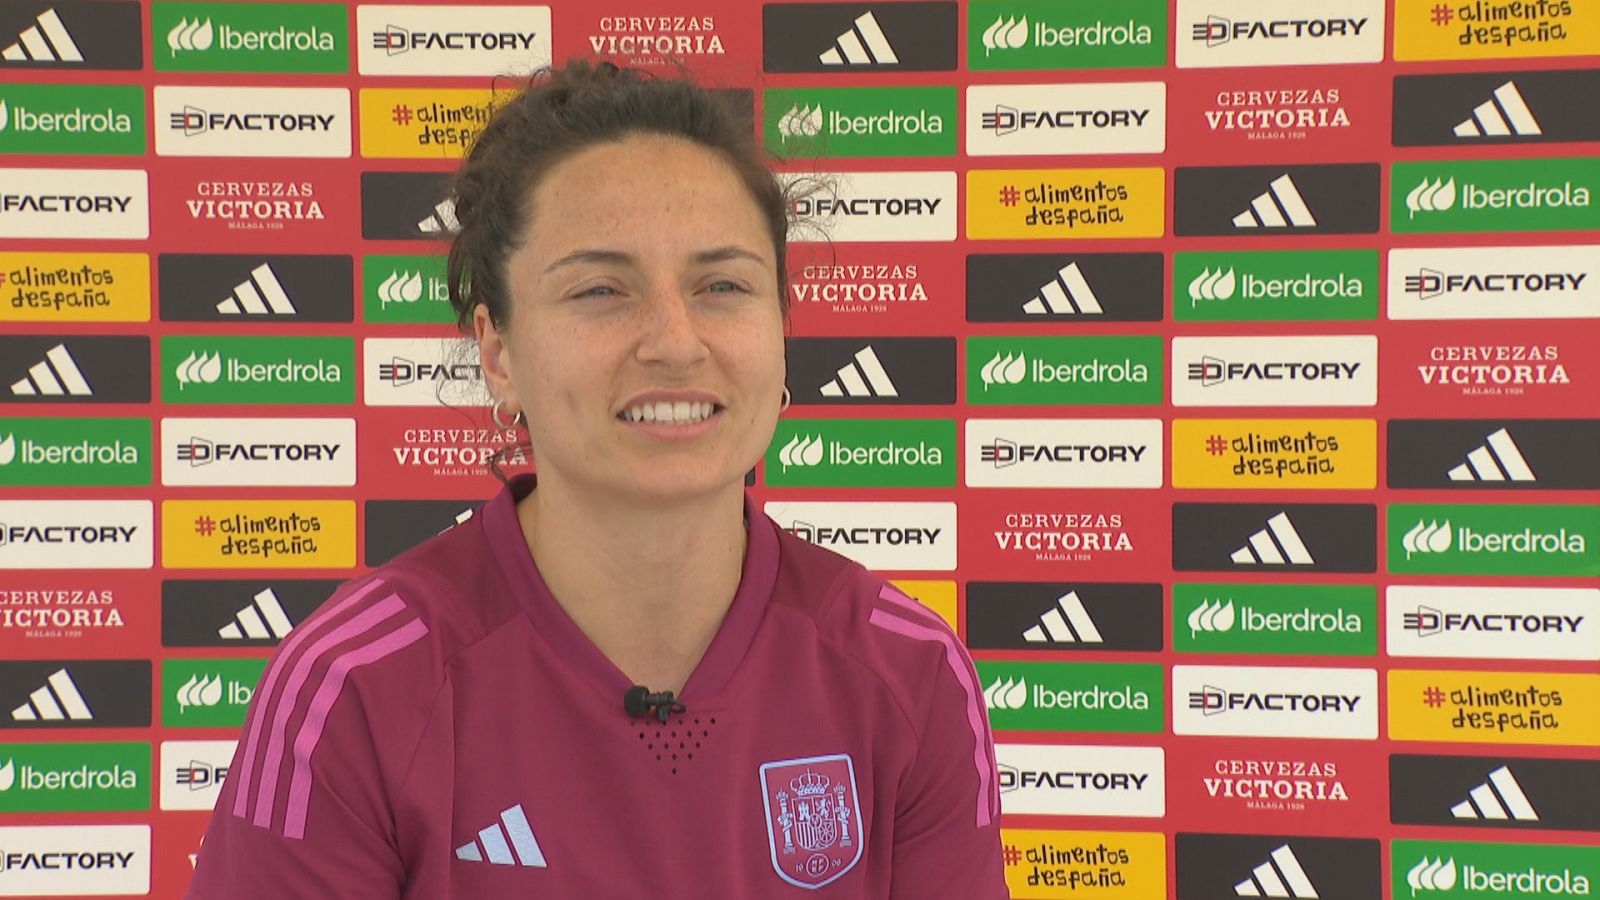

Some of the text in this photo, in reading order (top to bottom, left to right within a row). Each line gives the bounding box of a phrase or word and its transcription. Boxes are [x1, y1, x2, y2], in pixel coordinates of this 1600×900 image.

[600, 17, 713, 31] CERVEZAS
[1035, 20, 1151, 46] Iberdrola
[220, 26, 333, 50] Iberdrola
[588, 34, 725, 56] VICTORIA
[1218, 89, 1339, 106] CERVEZAS
[14, 107, 130, 132] Iberdrola
[391, 103, 495, 126] #alimen
[830, 110, 942, 134] Iberdrola
[1205, 108, 1350, 129] VICTORIA
[419, 126, 477, 146] desp
[198, 182, 312, 196] CERVEZAS
[1463, 182, 1589, 208] Iberdrola
[187, 200, 324, 219] VICTORIA
[803, 265, 917, 281] CERVEZAS
[792, 282, 929, 302] VICTORIA
[1243, 273, 1362, 298] Iberdrola
[1431, 346, 1558, 360] CERVEZAS
[228, 358, 340, 382] Iberdrola
[418, 364, 481, 380] FACT
[1033, 359, 1147, 382] Iberdrola
[1418, 365, 1569, 384] VICTORIA
[404, 428, 517, 444] CERVEZAS
[22, 440, 137, 464] Iberdrola
[830, 442, 941, 464] Iberdrola
[1006, 514, 1121, 528] CERVEZAS
[995, 532, 1133, 550] VICTORIA
[1460, 528, 1585, 553] Iberdrola
[0, 609, 123, 627] ICTORIA
[1242, 607, 1361, 632] Iberdrola
[1034, 685, 1148, 709] Iberdrola
[21, 765, 136, 789] Iberdrola
[1216, 760, 1336, 777] CERVEZAS
[1204, 779, 1348, 800] VICTORIA
[1464, 865, 1589, 894] Iberdrola
